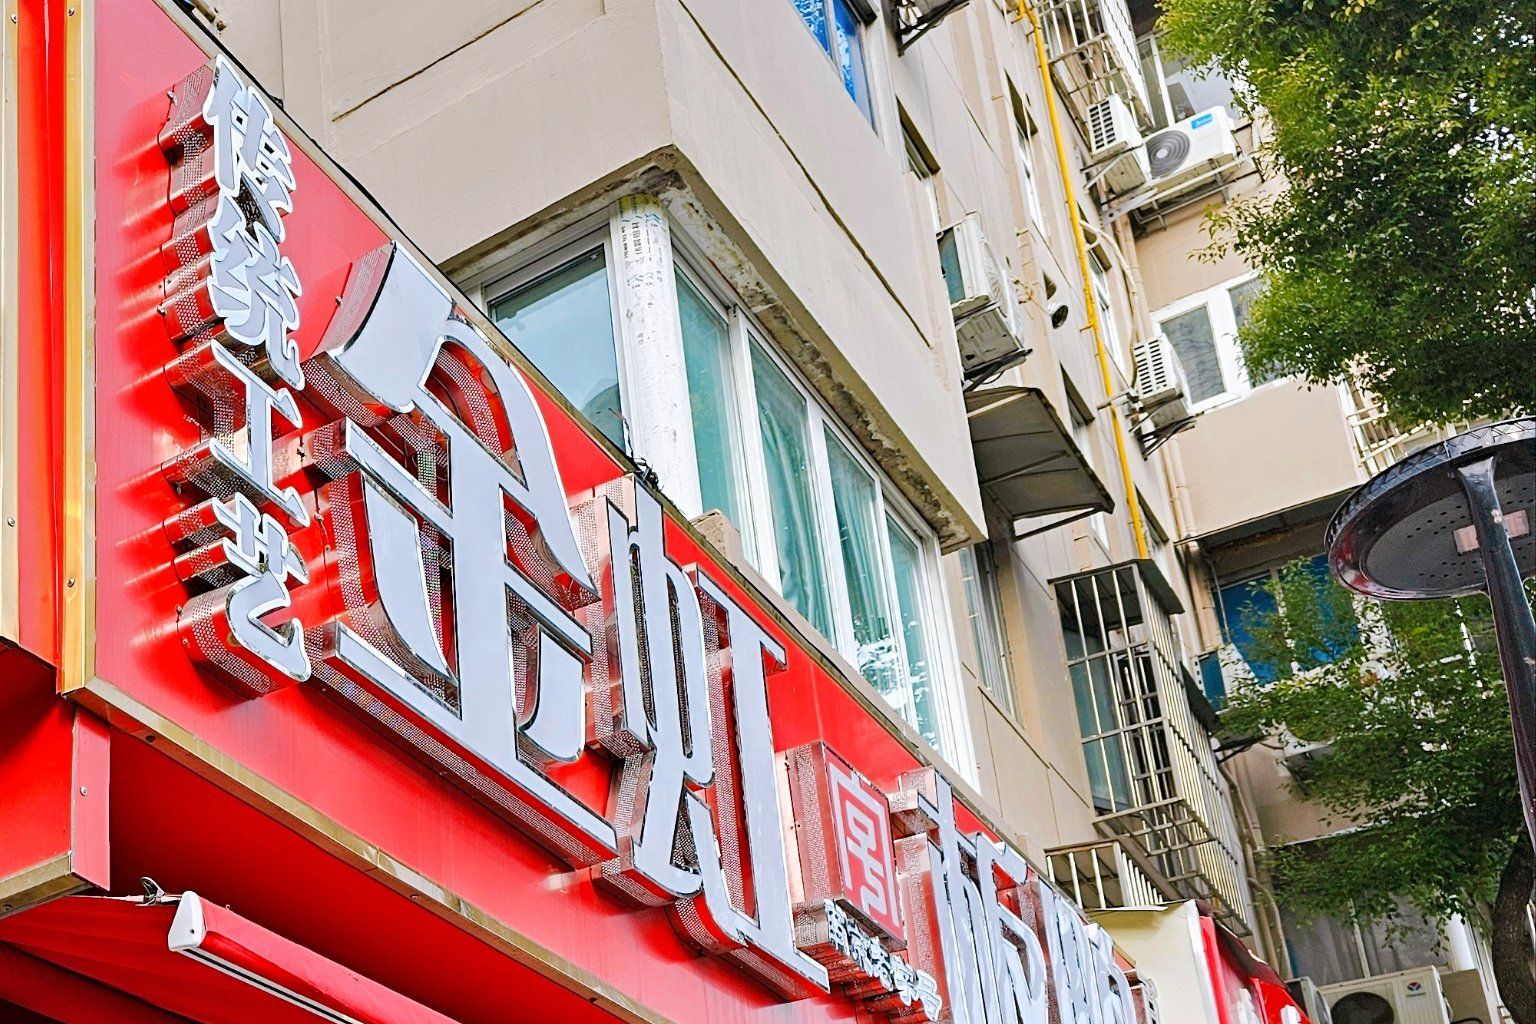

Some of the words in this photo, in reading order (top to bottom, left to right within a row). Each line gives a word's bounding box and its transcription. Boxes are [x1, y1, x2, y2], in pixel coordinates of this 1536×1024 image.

[203, 54, 311, 682] 传统工艺
[336, 241, 831, 994] 金虹
[824, 899, 942, 1021] 南京老字号
